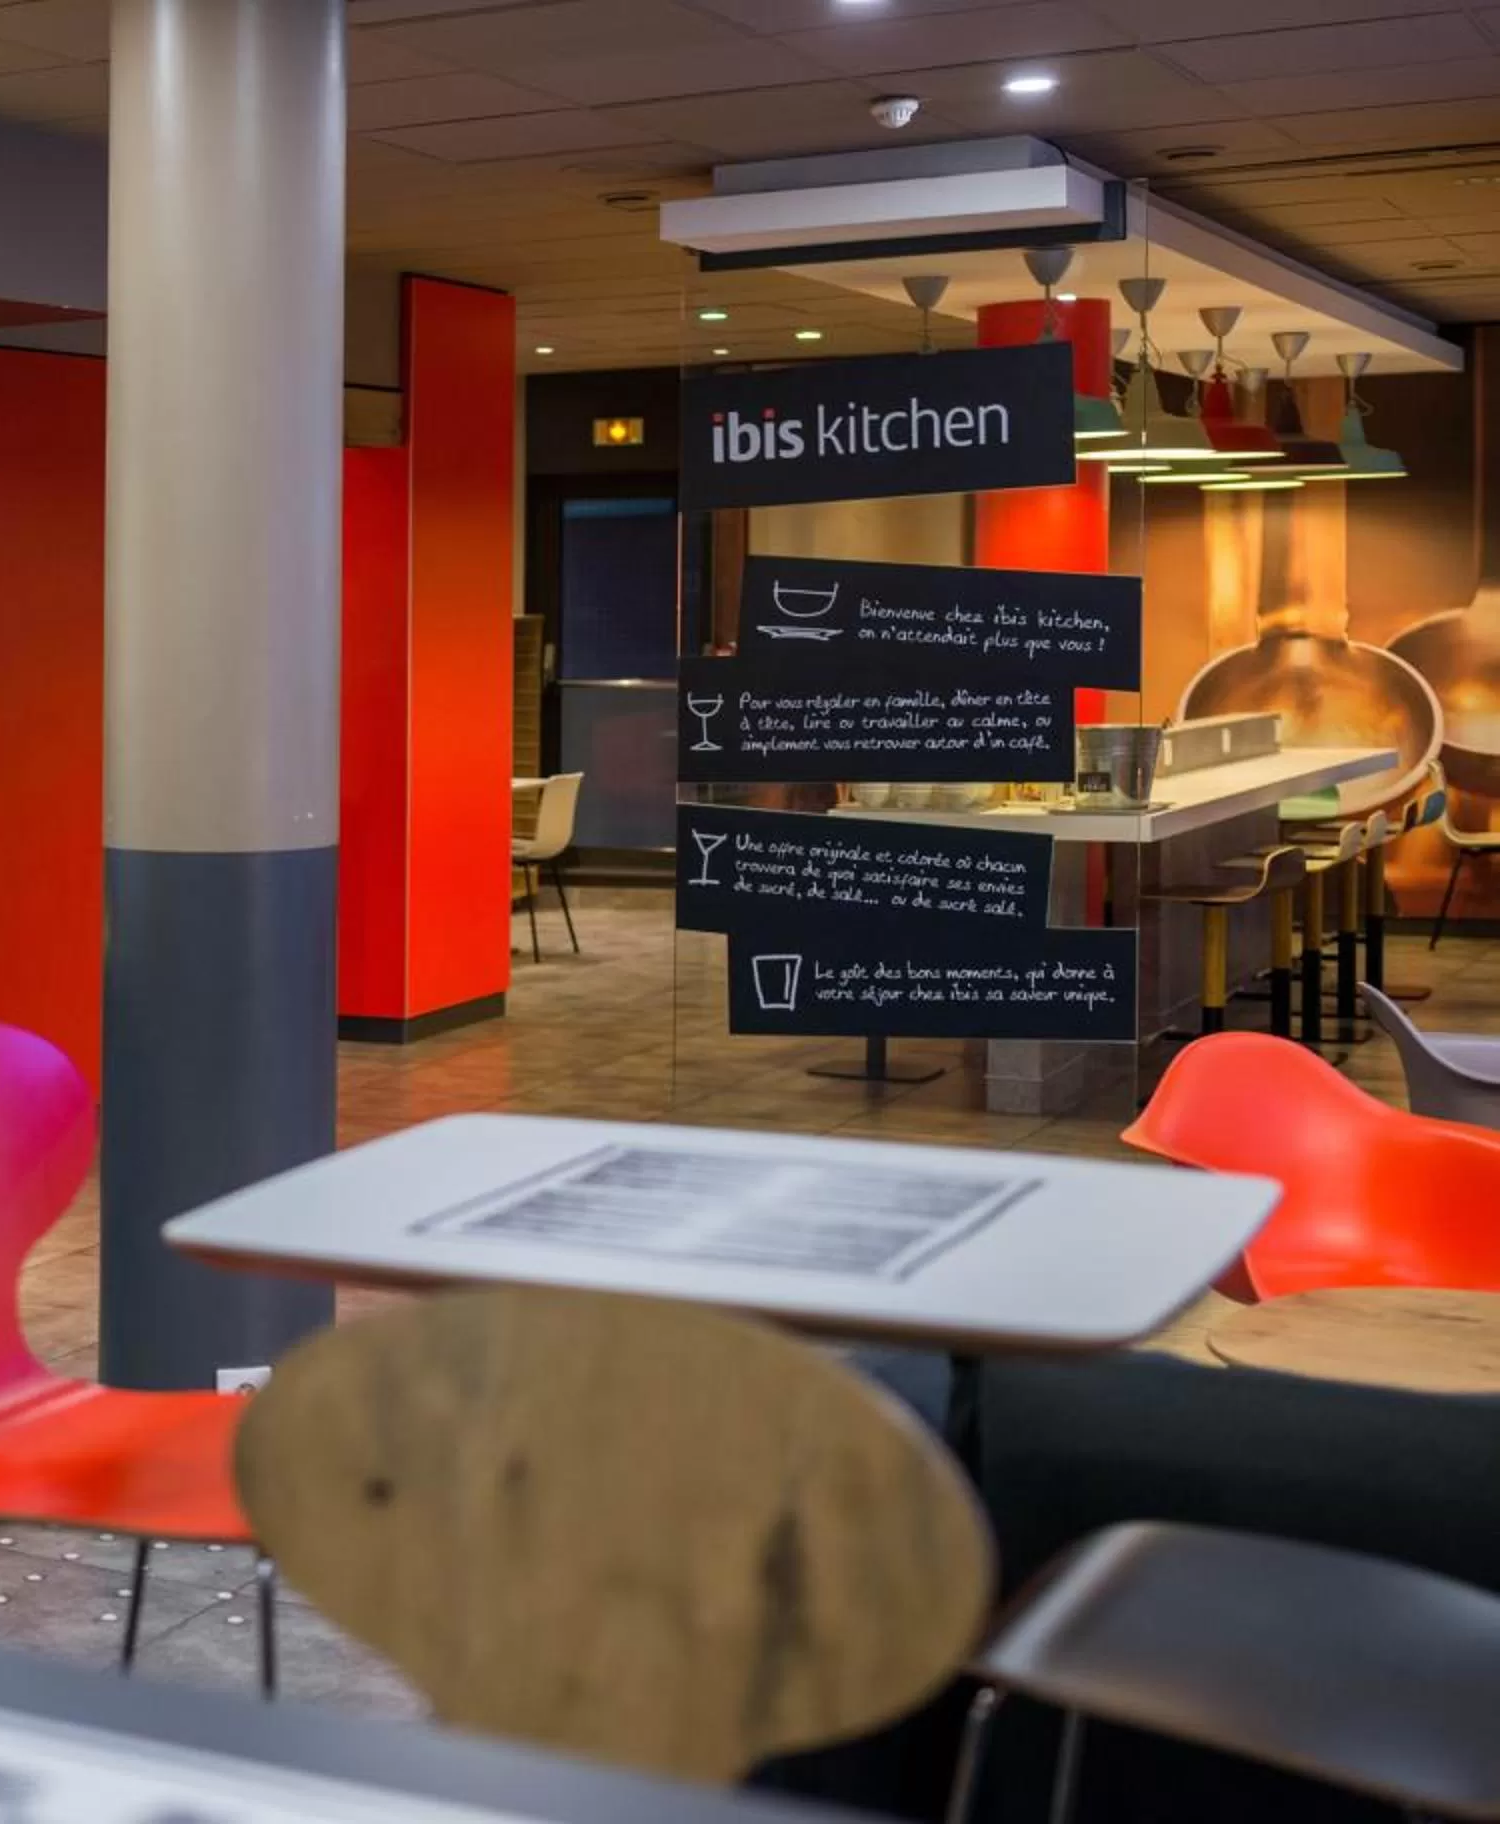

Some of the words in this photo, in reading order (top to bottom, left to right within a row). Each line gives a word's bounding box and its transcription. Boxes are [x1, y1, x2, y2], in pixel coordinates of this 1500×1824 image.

[712, 408, 805, 463] ibis
[817, 398, 1009, 456] kitchen
[859, 598, 935, 621] Bienvenue
[945, 604, 984, 624] chez
[993, 604, 1027, 626] ibis
[1037, 608, 1110, 632] kitchen,
[857, 628, 875, 640] on
[881, 625, 978, 645] n'attendait
[983, 631, 1018, 653] plus
[1024, 638, 1051, 660] que
[1059, 640, 1092, 652] vous
[739, 692, 772, 709] Pour
[775, 699, 803, 709] vous
[806, 693, 860, 716] régaler
[863, 697, 881, 708] en
[885, 690, 945, 713] famille,
[951, 689, 991, 706] dîner
[996, 695, 1013, 705] en
[1017, 690, 1051, 705] tête
[739, 716, 750, 731] à
[803, 713, 831, 729] lire
[839, 718, 855, 729] ou
[862, 711, 939, 729] travailler
[946, 717, 964, 727] au
[971, 711, 1027, 729] calme,
[1035, 717, 1052, 727] ou
[741, 734, 819, 758] simplement
[823, 739, 851, 750] vous
[854, 738, 921, 749] retrouver
[924, 738, 969, 749] autour
[973, 730, 1005, 749] d'un
[1009, 734, 1050, 754] café.
[736, 833, 764, 853] Une
[768, 842, 804, 860] offre
[809, 840, 870, 865] originale
[875, 852, 893, 863] et
[898, 850, 951, 868] colorée
[955, 856, 972, 869] où
[976, 854, 1026, 873] chacun
[733, 875, 753, 892] de
[807, 881, 826, 898] de
[891, 895, 907, 905] ou
[912, 890, 932, 908] de
[938, 898, 977, 912] sucré
[735, 860, 796, 875] trouvera
[802, 859, 821, 878] de
[828, 863, 857, 889] quoi
[861, 867, 939, 890] satisfaire
[946, 879, 971, 891] ses
[978, 876, 1025, 895] envies
[815, 960, 834, 979] Le
[838, 963, 869, 987] goût
[873, 961, 901, 979] des
[907, 960, 941, 979] bons
[946, 967, 1019, 981] moments,
[1025, 961, 1047, 988] qui
[1052, 961, 1097, 979] donne
[1103, 963, 1115, 980] à
[815, 988, 854, 1000] votre
[860, 985, 904, 1007] séjour
[909, 984, 944, 1000] chez
[950, 982, 979, 1001] ibis
[986, 989, 1004, 1001] sa
[1010, 989, 1059, 1001] saveur
[1063, 983, 1115, 1012] unique.
